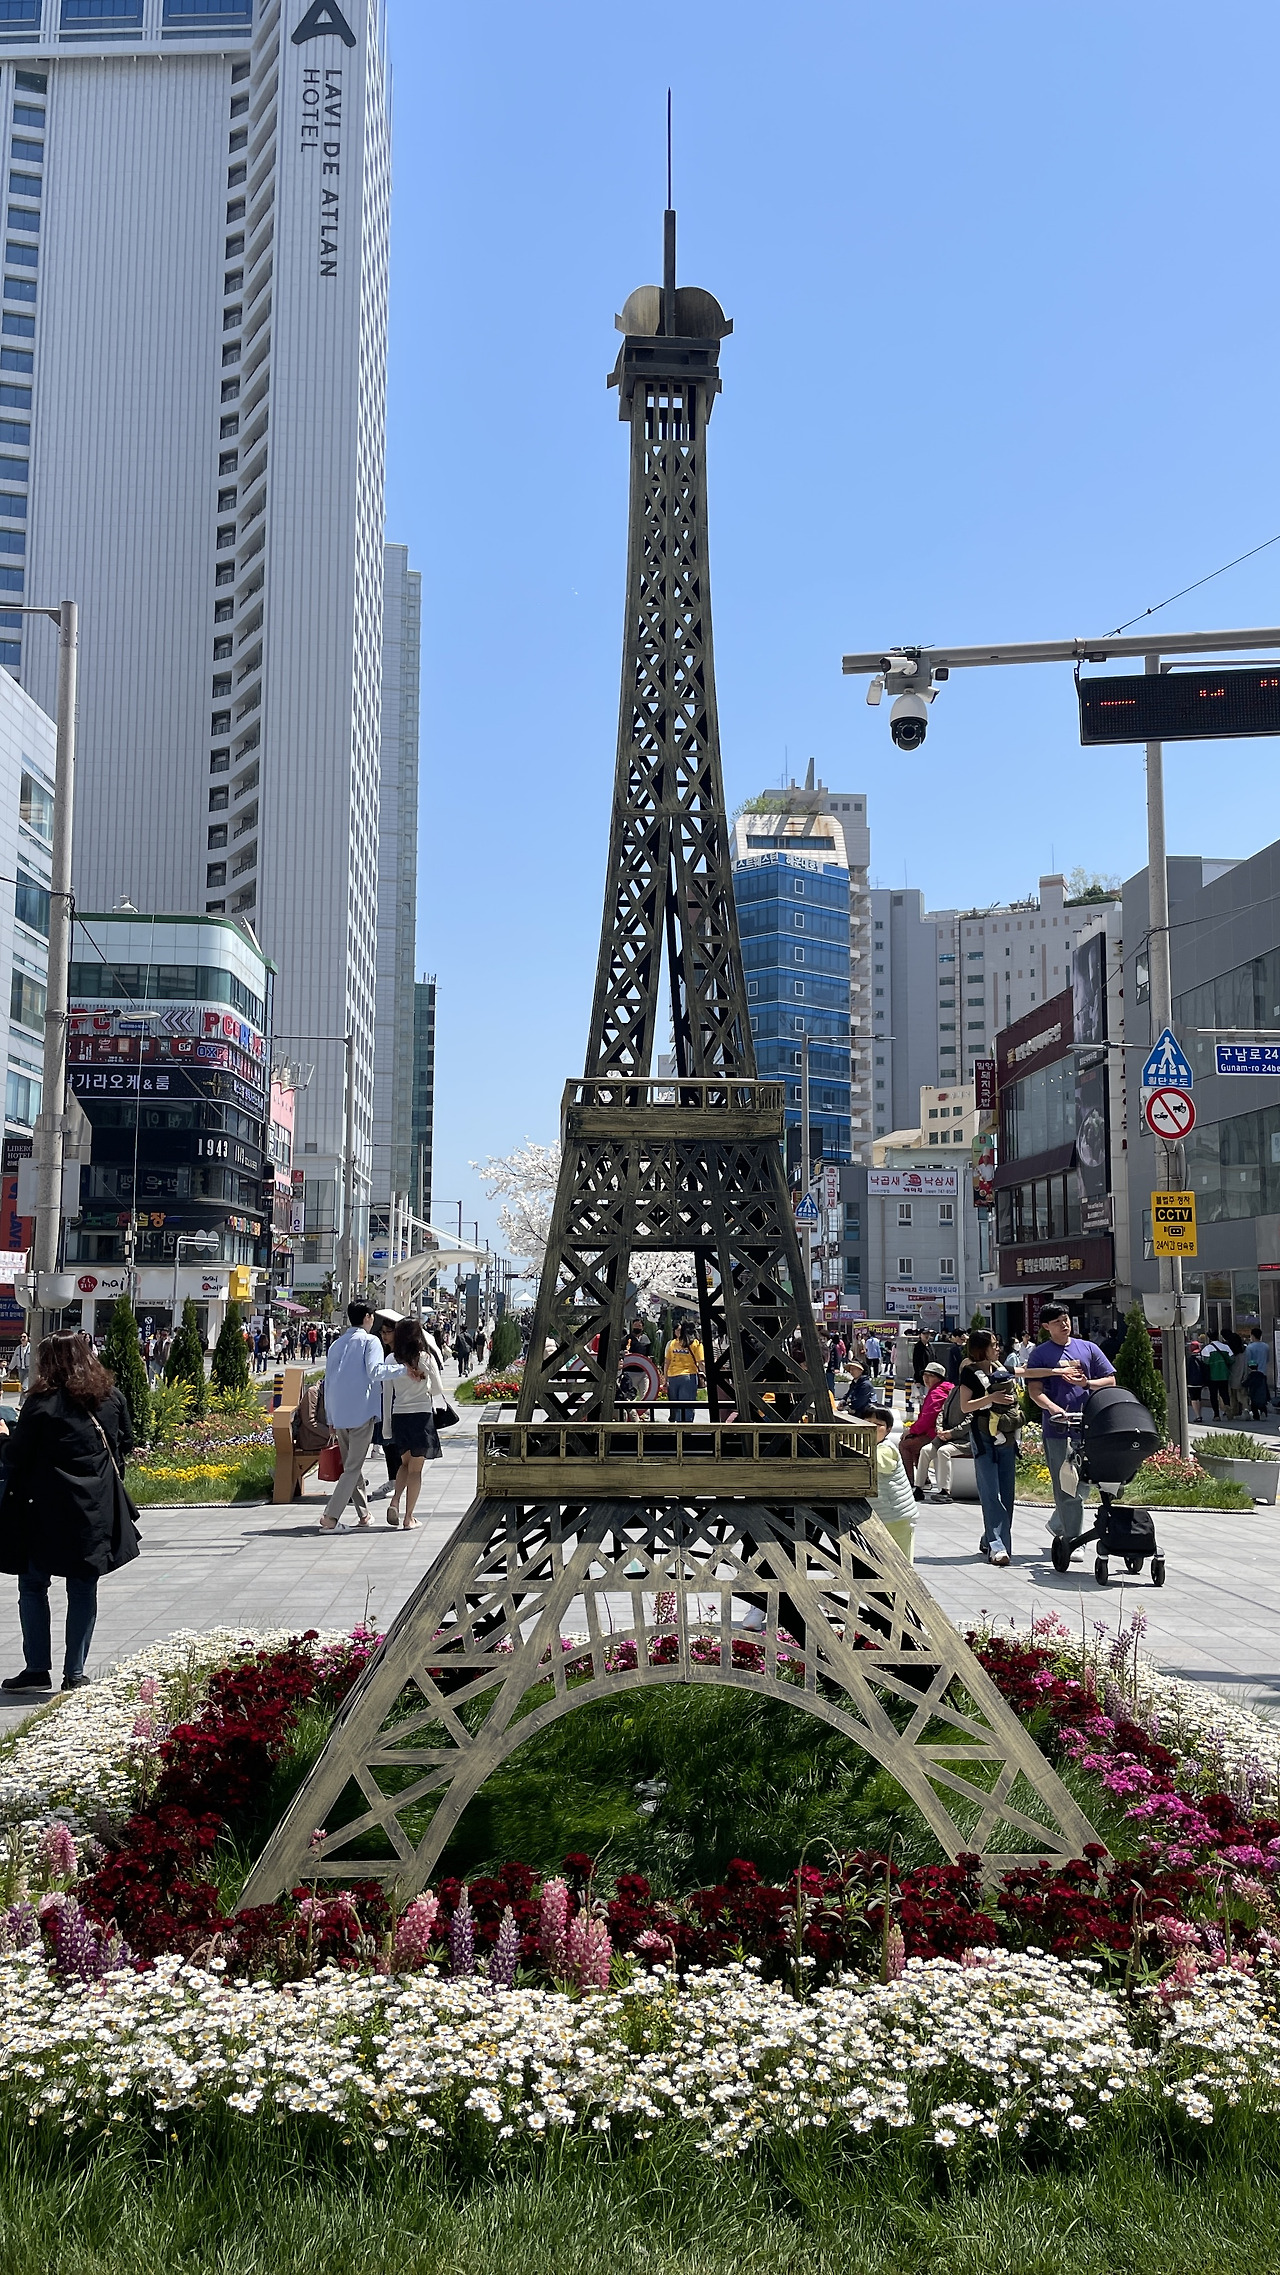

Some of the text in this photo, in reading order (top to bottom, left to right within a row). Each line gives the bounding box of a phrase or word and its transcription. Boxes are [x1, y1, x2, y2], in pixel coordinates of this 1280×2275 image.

[300, 69, 320, 153] HOTEL
[320, 69, 342, 278] LAVI DE ATLAN
[1221, 1064, 1259, 1072] Gunam-ro
[1148, 1077, 1189, 1086] 횡단보도
[198, 1138, 228, 1158] 1943
[869, 1175, 955, 1188] 낙곱새 낙삼새
[827, 1179, 836, 1208] 낙곱새
[1157, 1209, 1190, 1221] CCTV
[293, 1219, 300, 1232] CU
[824, 1291, 837, 1306] P
